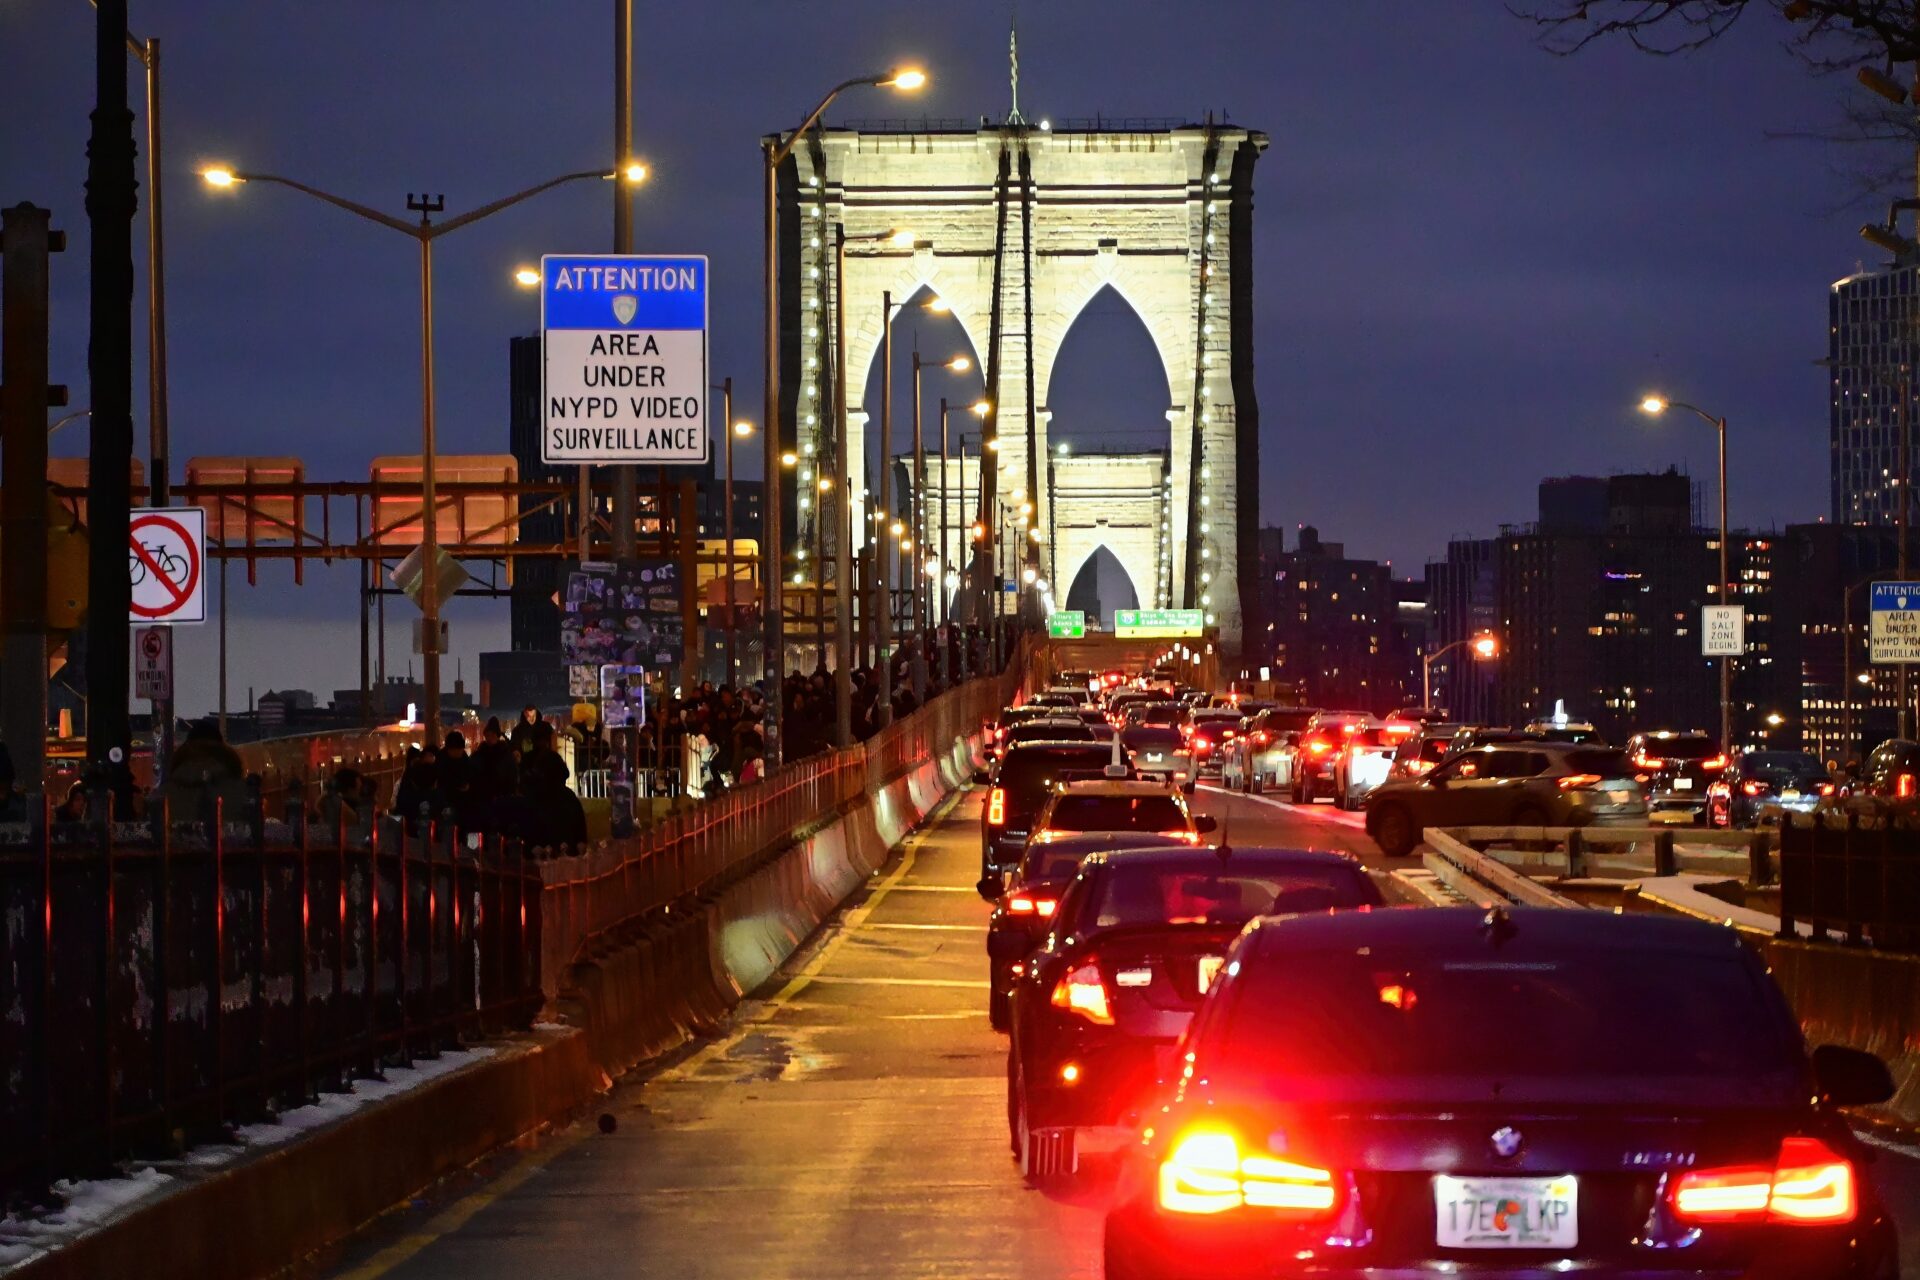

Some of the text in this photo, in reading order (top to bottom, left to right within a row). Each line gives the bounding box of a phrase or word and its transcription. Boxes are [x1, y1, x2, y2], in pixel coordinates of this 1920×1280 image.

[555, 267, 696, 290] ATTENTION
[590, 334, 660, 356] AREA
[583, 366, 665, 387] UNDER
[551, 397, 698, 418] NYPD VIDEO
[552, 428, 698, 449] SURVEILLANCE
[1875, 586, 1920, 596] ATTENTIO
[1716, 611, 1730, 619] NO
[1888, 611, 1915, 621] AREA
[1711, 621, 1735, 630] SALT
[1885, 624, 1918, 634] UNDER
[1711, 631, 1735, 640] ZONE
[1708, 641, 1738, 650] BEGINS
[1873, 637, 1899, 646] NYPD
[1874, 649, 1920, 659] SURVEILLAN
[147, 660, 157, 669] NO
[138, 670, 166, 681] VENDING
